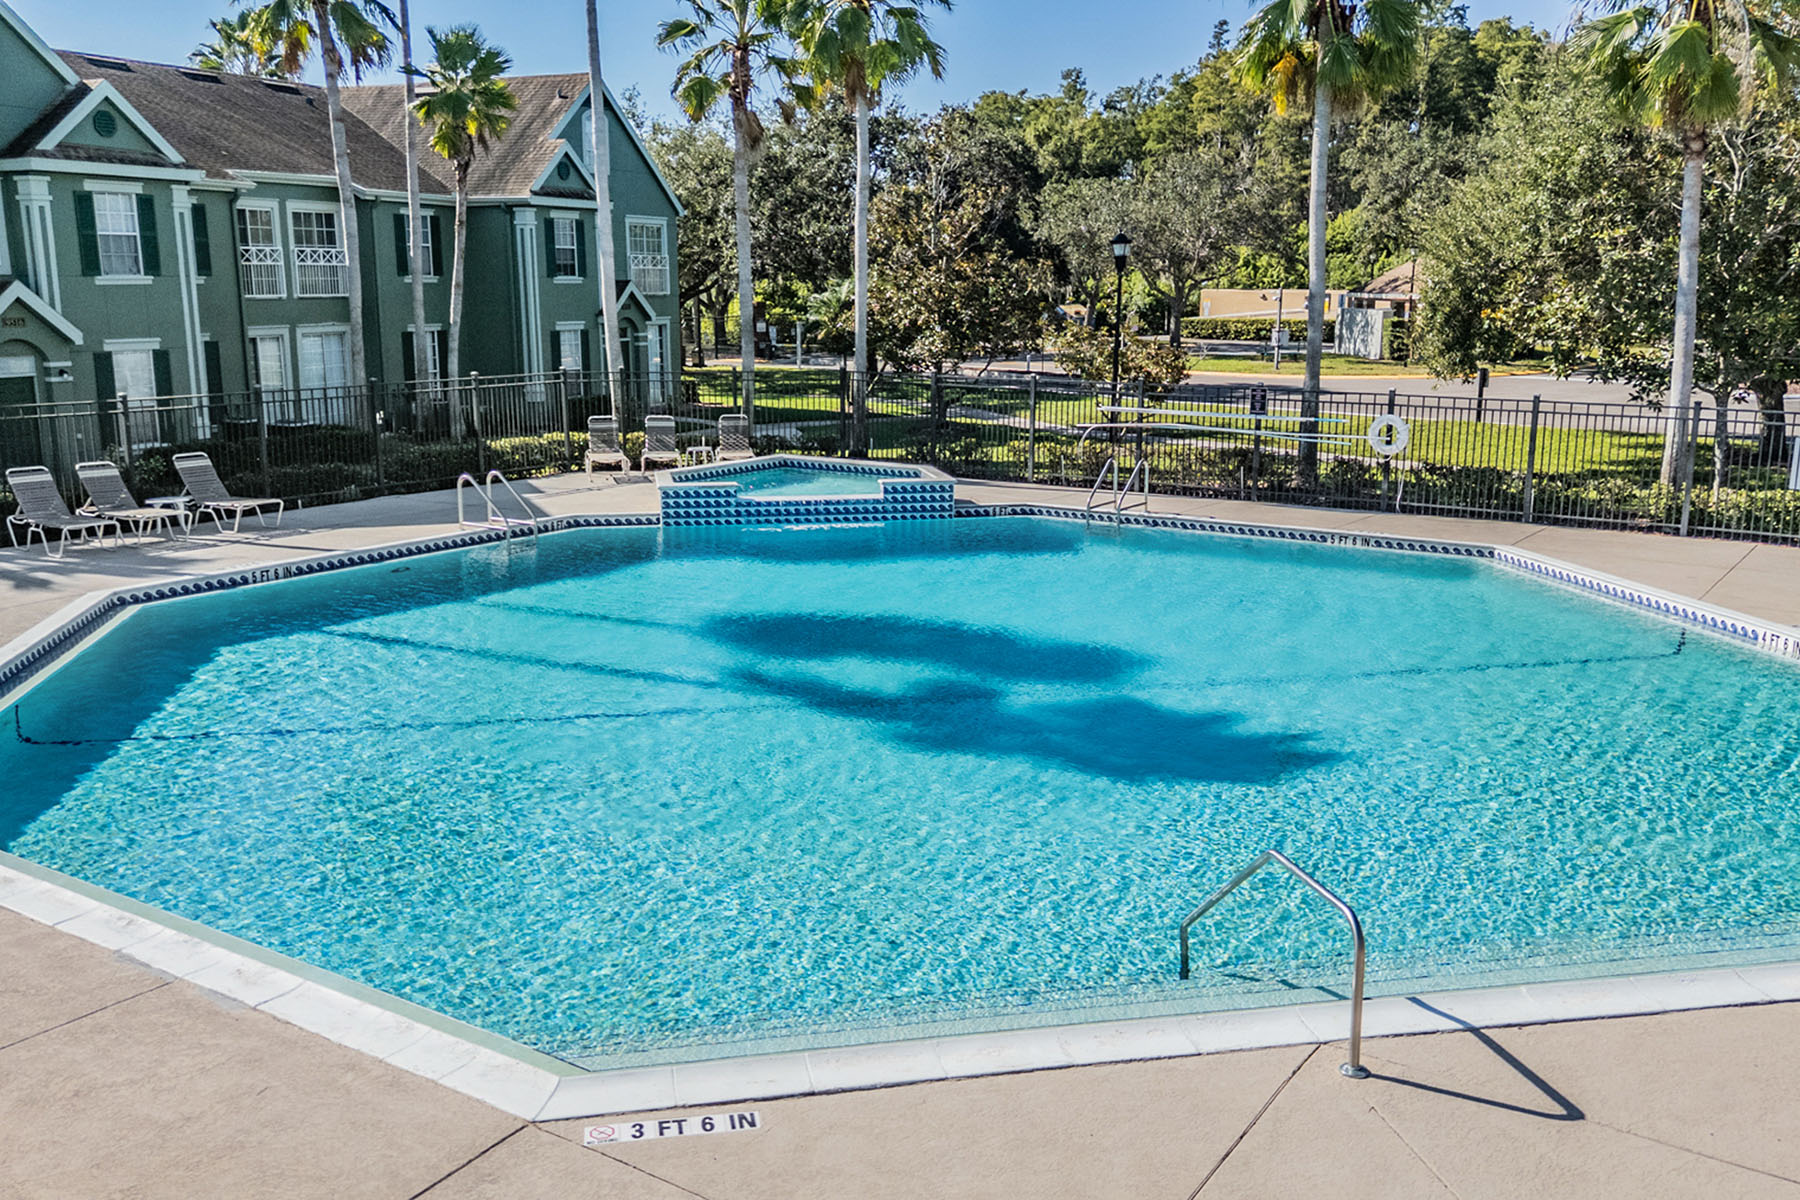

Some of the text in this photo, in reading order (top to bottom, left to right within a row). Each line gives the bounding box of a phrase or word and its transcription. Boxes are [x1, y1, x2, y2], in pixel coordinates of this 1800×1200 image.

[1000, 506, 1008, 516] FT
[556, 519, 564, 531] FT
[1330, 534, 1370, 547] 5 FT 6 IN
[251, 565, 292, 584] 5 FT 6 IN
[1762, 631, 1767, 648] 4
[1769, 633, 1780, 651] FT
[1783, 637, 1789, 651] 6
[631, 1112, 757, 1139] 3 FT 6 IN
